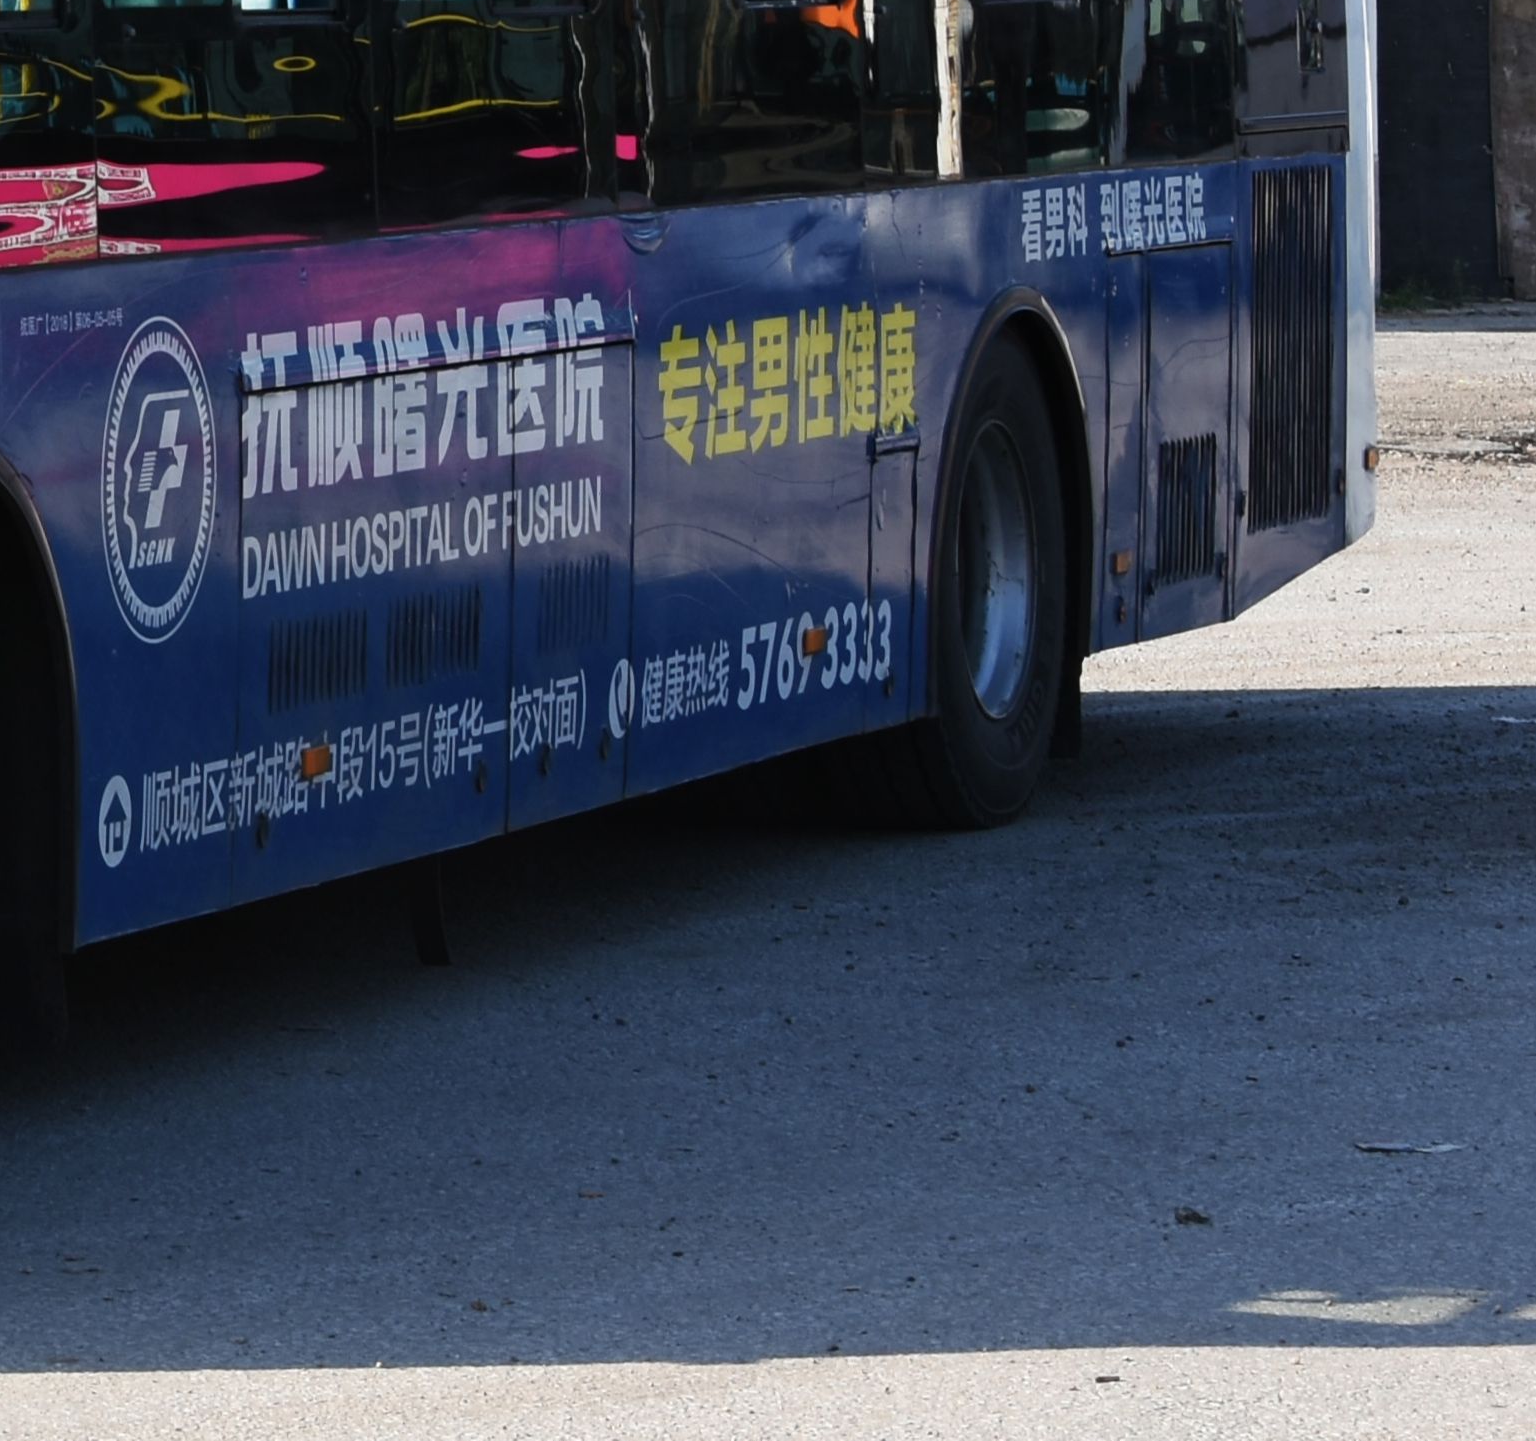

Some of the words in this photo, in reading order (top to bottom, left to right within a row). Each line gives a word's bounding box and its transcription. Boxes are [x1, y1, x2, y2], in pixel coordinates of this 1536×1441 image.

[1021, 183, 1088, 263] 看男科
[1100, 171, 1206, 251] 到曙光医院
[242, 292, 604, 499] 抚顺曙光医院
[658, 300, 917, 465] 专注男性健康
[243, 523, 325, 599] DAWN
[331, 502, 459, 582] HOSPITAL
[464, 493, 498, 557] OF
[502, 475, 601, 550] FUSHUN
[641, 638, 729, 728] 健康热线
